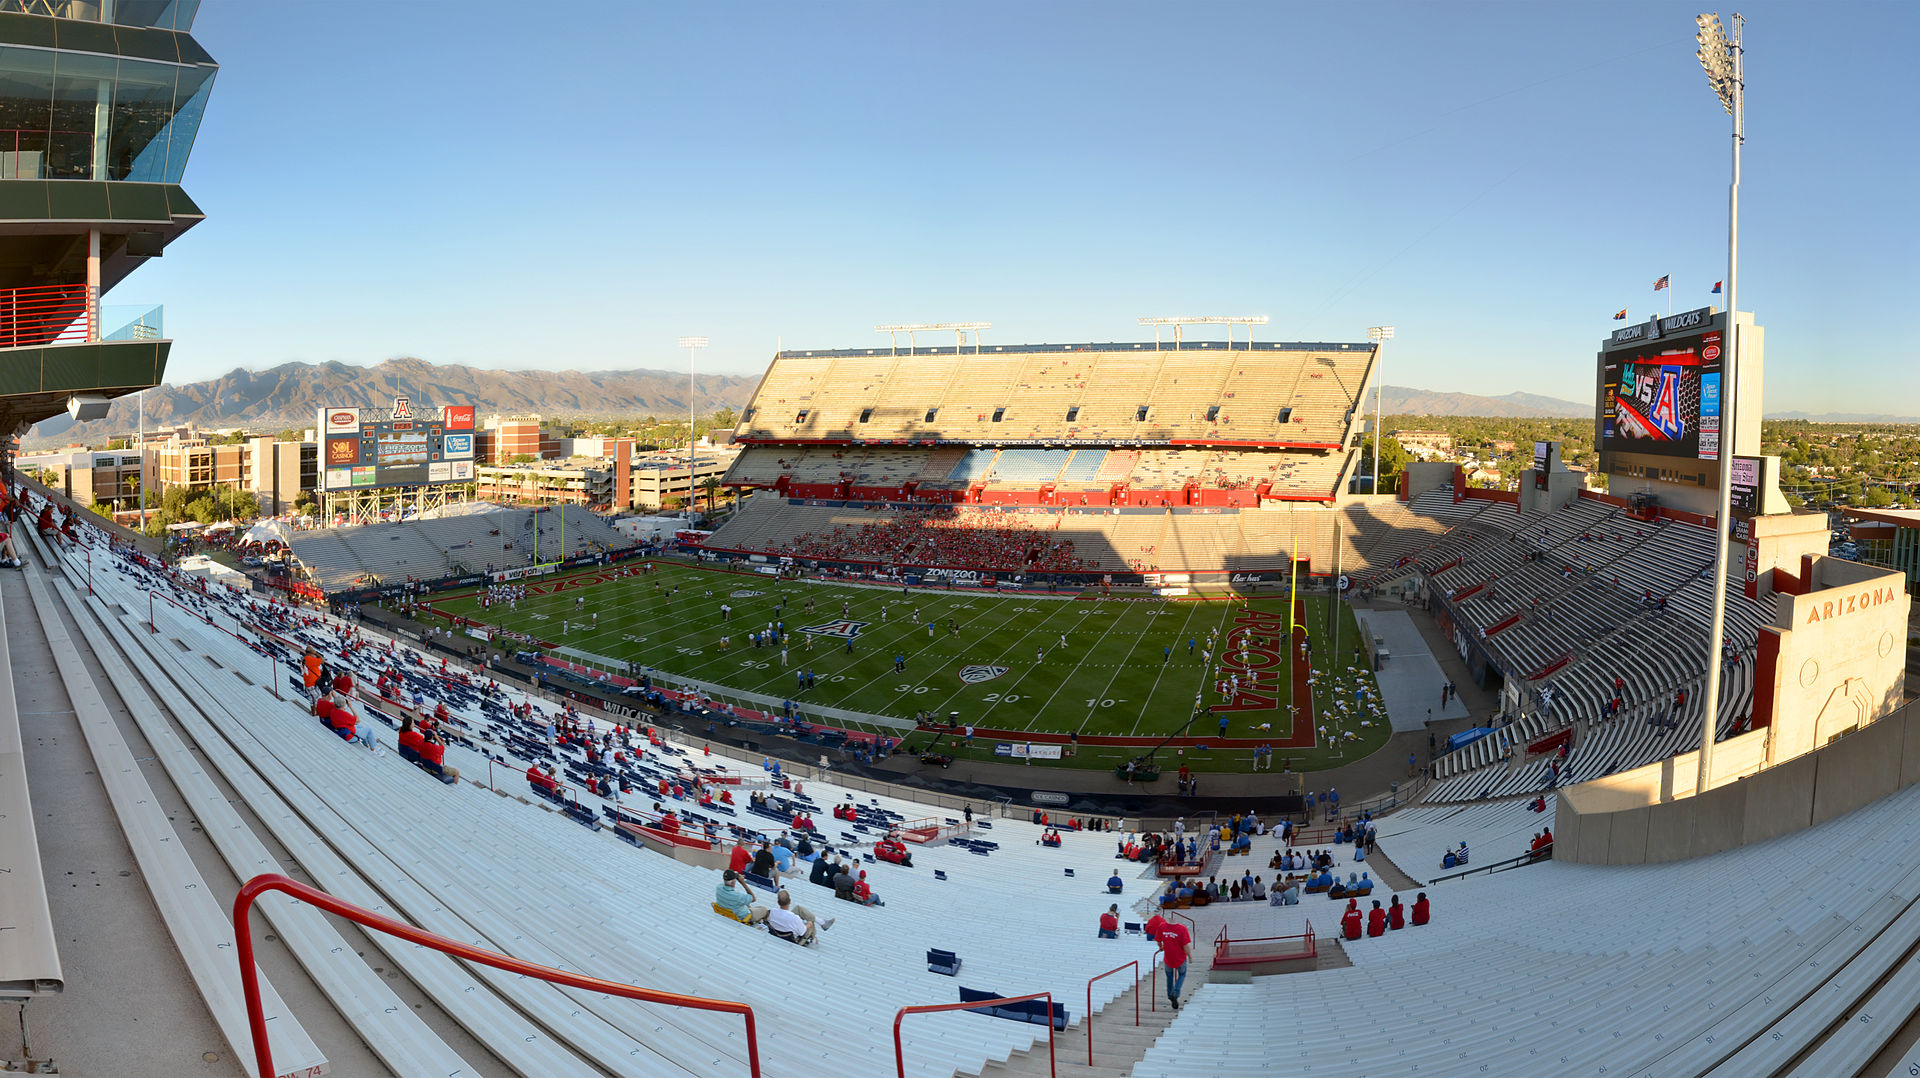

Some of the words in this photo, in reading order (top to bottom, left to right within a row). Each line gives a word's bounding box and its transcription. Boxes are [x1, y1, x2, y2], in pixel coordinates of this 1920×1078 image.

[1665, 312, 1700, 330] WILDCATS
[1616, 326, 1642, 341] ARIZONA
[1635, 375, 1654, 404] VS
[332, 442, 354, 454] SOL
[1732, 460, 1753, 472] Arizona
[1743, 472, 1754, 483] Star
[1806, 586, 1895, 624] ARIZONA
[621, 633, 648, 643] 30
[676, 645, 704, 656] 40
[1209, 607, 1282, 712] ARIZONA
[739, 660, 771, 670] 50
[814, 672, 846, 683] 40
[894, 684, 929, 694] 30
[981, 692, 1021, 704] 20
[1085, 697, 1117, 708] 10
[603, 700, 655, 724] WILDCATS
[183, 882, 198, 890] 3
[216, 941, 232, 949] 2
[330, 946, 343, 955] 3
[1809, 960, 1820, 969] 16
[464, 985, 476, 994] 3
[385, 1005, 398, 1014] 2
[1708, 1001, 1717, 1011] 17
[1860, 1013, 1874, 1025] 18
[526, 1034, 538, 1043] 2
[1705, 1034, 1717, 1045] 18
[1772, 1031, 1785, 1042] 18
[630, 1048, 640, 1057] 2
[1458, 1051, 1469, 1060] 20
[712, 1058, 721, 1066] 2
[1560, 1055, 1570, 1064] 19
[305, 1065, 322, 1078] 74
[1479, 1064, 1489, 1073] 20
[1598, 1064, 1608, 1074] 19
